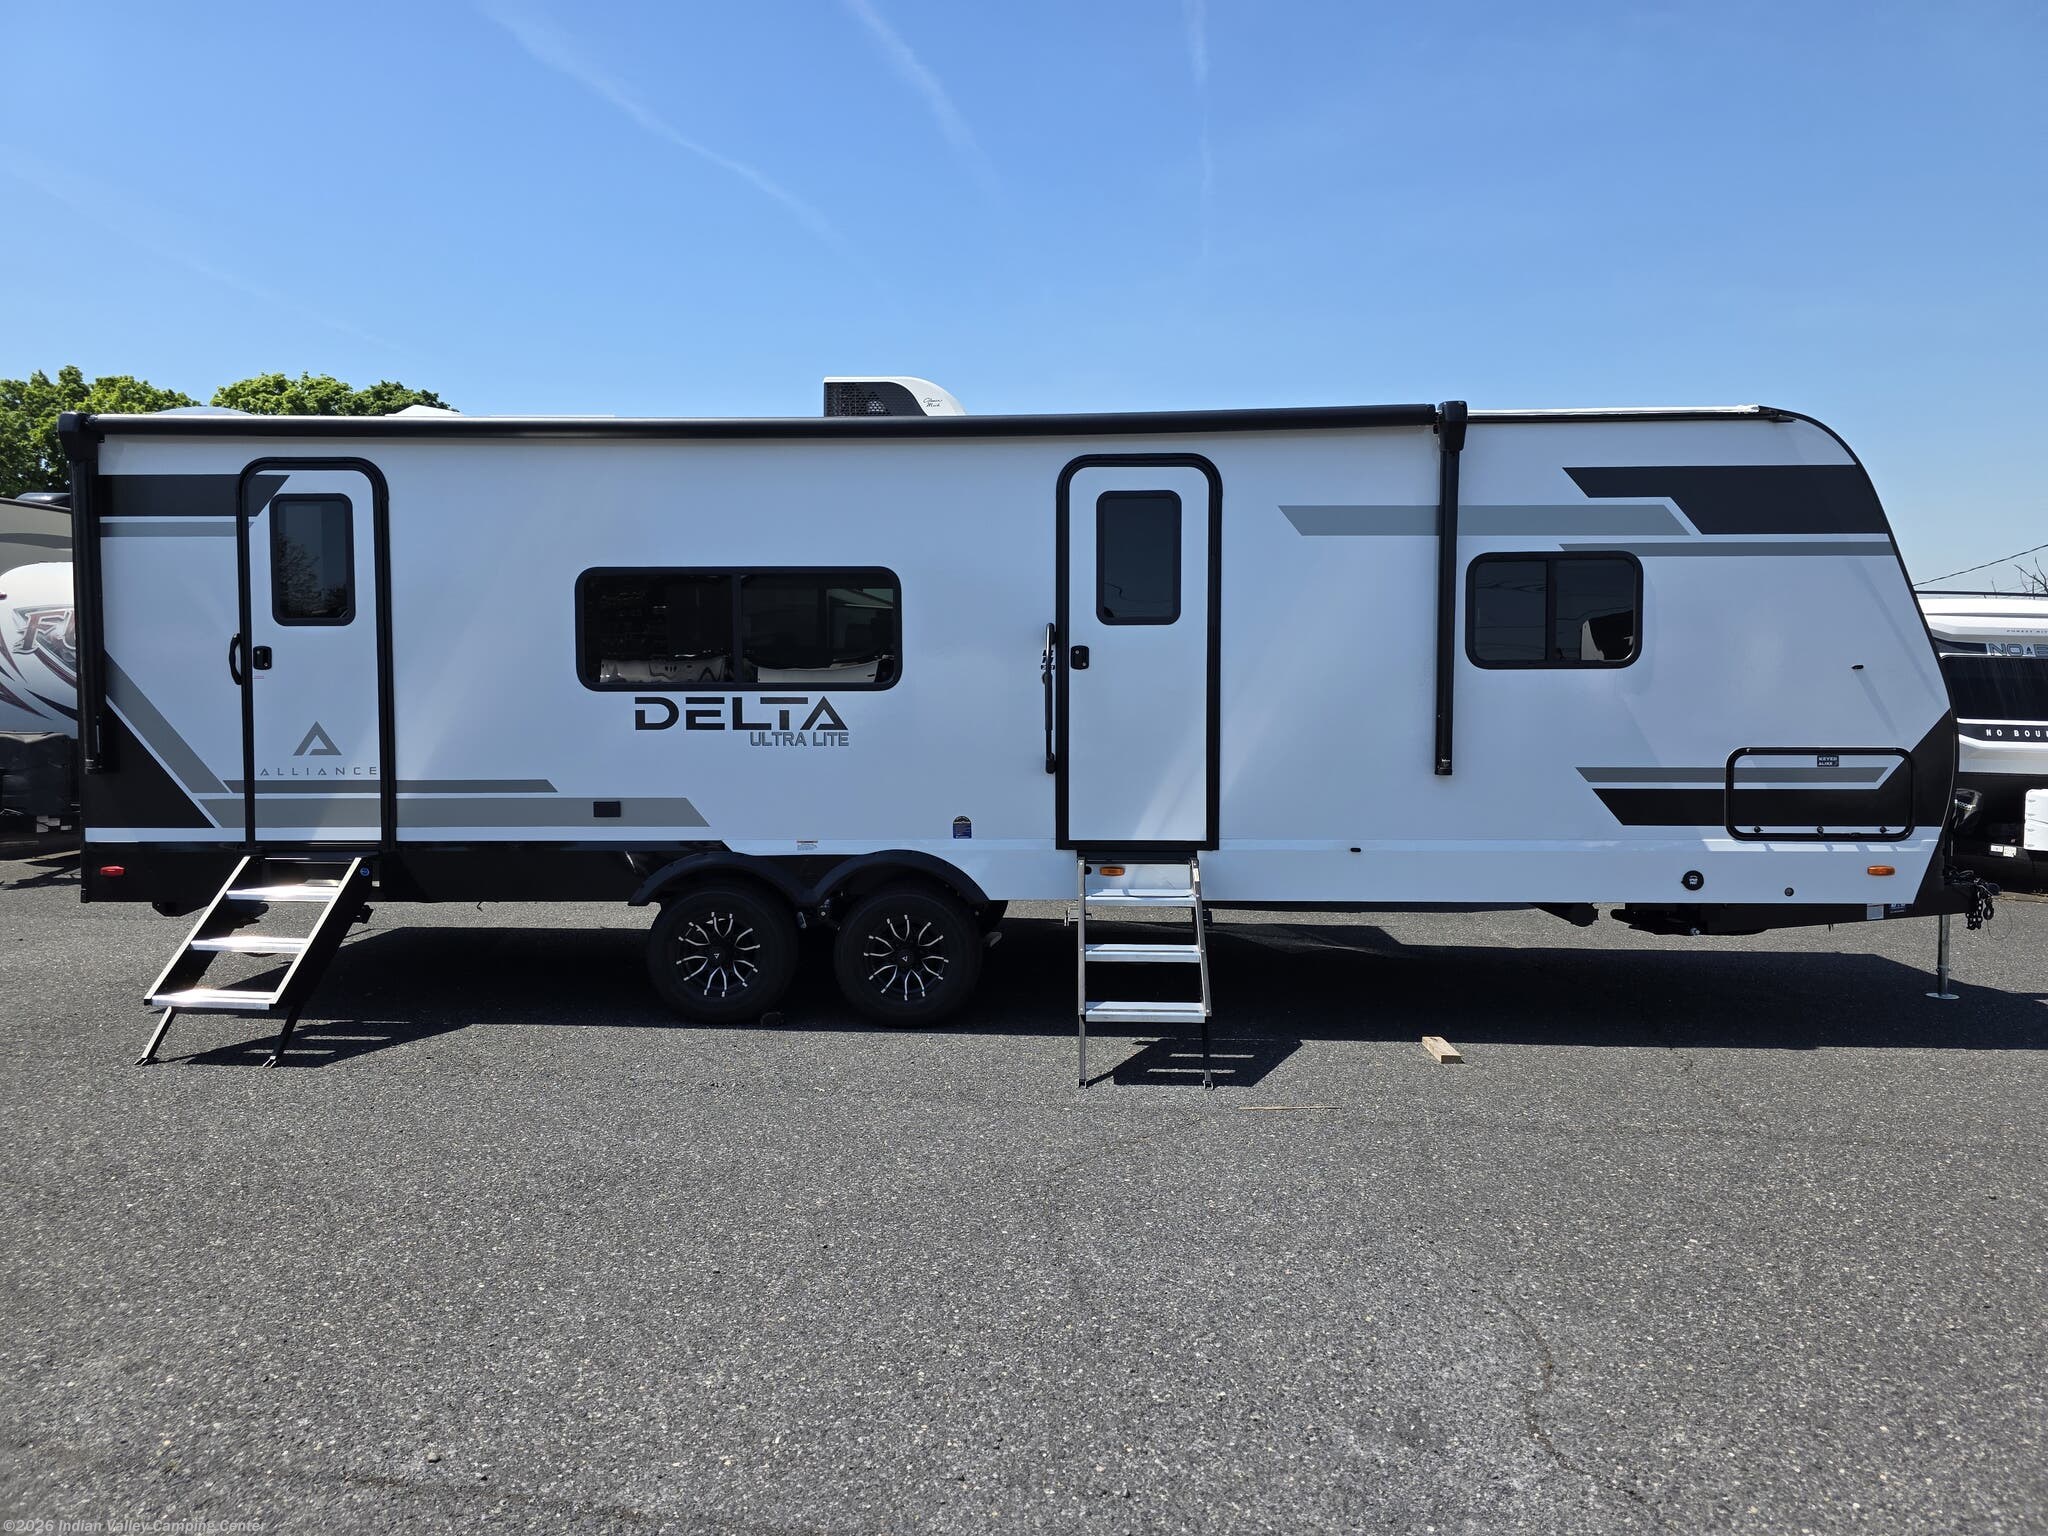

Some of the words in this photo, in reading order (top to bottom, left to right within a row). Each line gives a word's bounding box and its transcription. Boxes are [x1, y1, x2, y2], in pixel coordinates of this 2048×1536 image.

[635, 696, 849, 731] DELTA
[750, 731, 808, 747] ULTRA
[812, 731, 849, 747] LITE
[1985, 729, 2003, 737] NO
[260, 766, 377, 776] ALLIANCE
